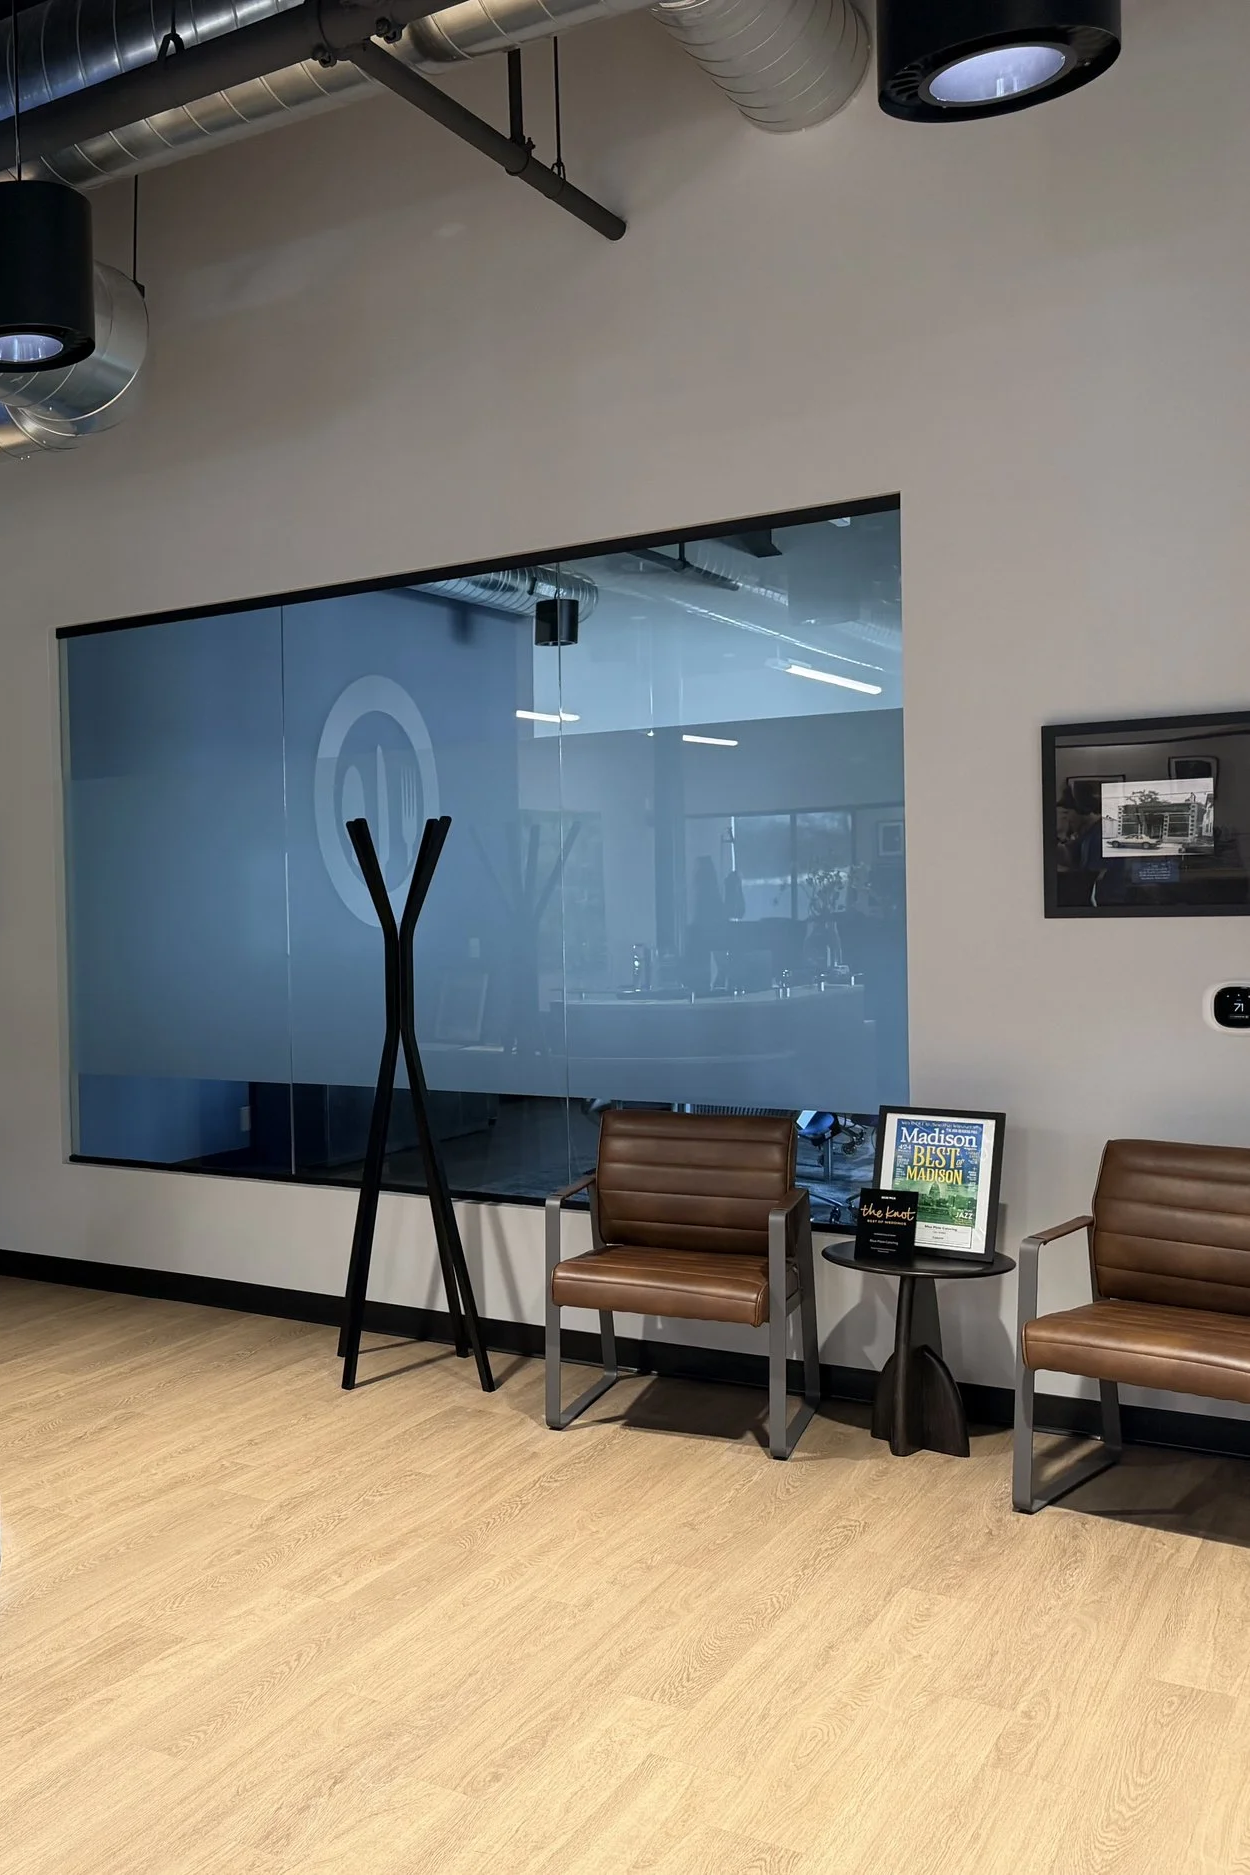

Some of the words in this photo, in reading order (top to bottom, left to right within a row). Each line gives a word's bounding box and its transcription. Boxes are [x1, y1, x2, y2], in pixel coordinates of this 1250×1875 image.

[1233, 1002, 1244, 1012] 71
[900, 1127, 977, 1147] Madison
[913, 1145, 960, 1169] BEST
[906, 1166, 962, 1185] MADISON
[860, 1202, 883, 1218] the
[885, 1205, 916, 1222] knot
[954, 1211, 973, 1220] JAZZ
